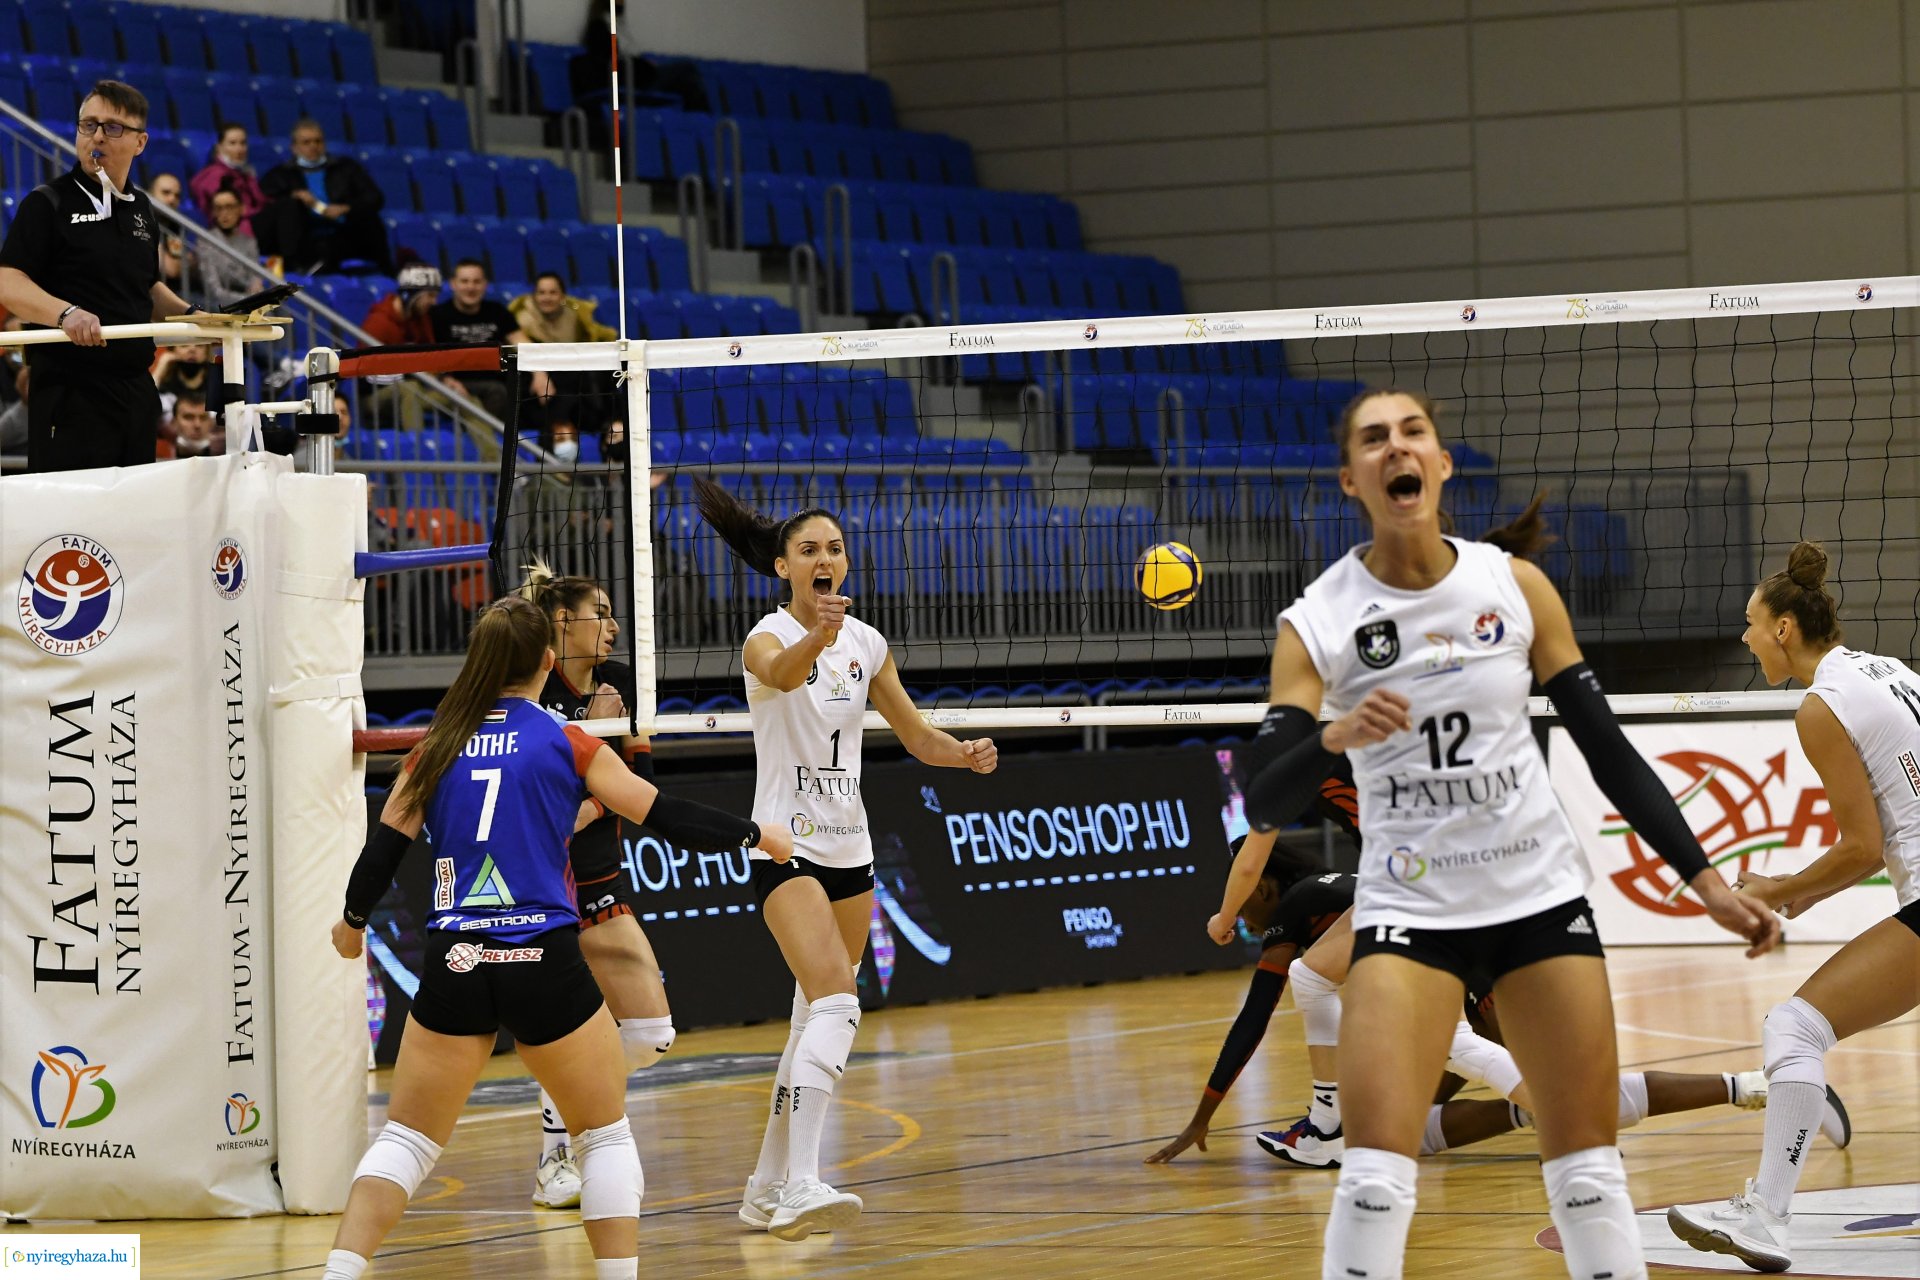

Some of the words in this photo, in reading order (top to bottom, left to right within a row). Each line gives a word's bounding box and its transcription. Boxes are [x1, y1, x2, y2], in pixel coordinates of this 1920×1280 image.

[71, 213, 102, 224] Zeus
[1709, 293, 1759, 308] FATUM
[1315, 313, 1362, 328] FATUM
[949, 332, 995, 347] FATUM
[62, 537, 112, 568] FATUM
[20, 596, 107, 653] NYÍREGYHÁZA
[1164, 708, 1202, 720] FATUM
[459, 732, 505, 758] ÓTH
[830, 729, 841, 768] 1
[1419, 711, 1474, 770] 12
[1383, 765, 1520, 808] FATUM
[471, 768, 501, 842] 7
[28, 690, 100, 996] FATUM
[105, 690, 142, 996] NYÍREGYHÁZA
[945, 799, 1191, 866] PENSOSHOP.HU
[441, 860, 449, 908] STRABAG
[459, 914, 546, 931] BESTRONG
[481, 949, 543, 963] REVESZ
[792, 1087, 800, 1112] KASA
[12, 1138, 137, 1160] NYÍREGYHÁZA
[216, 1138, 269, 1151] NYÍREGYHÁZA
